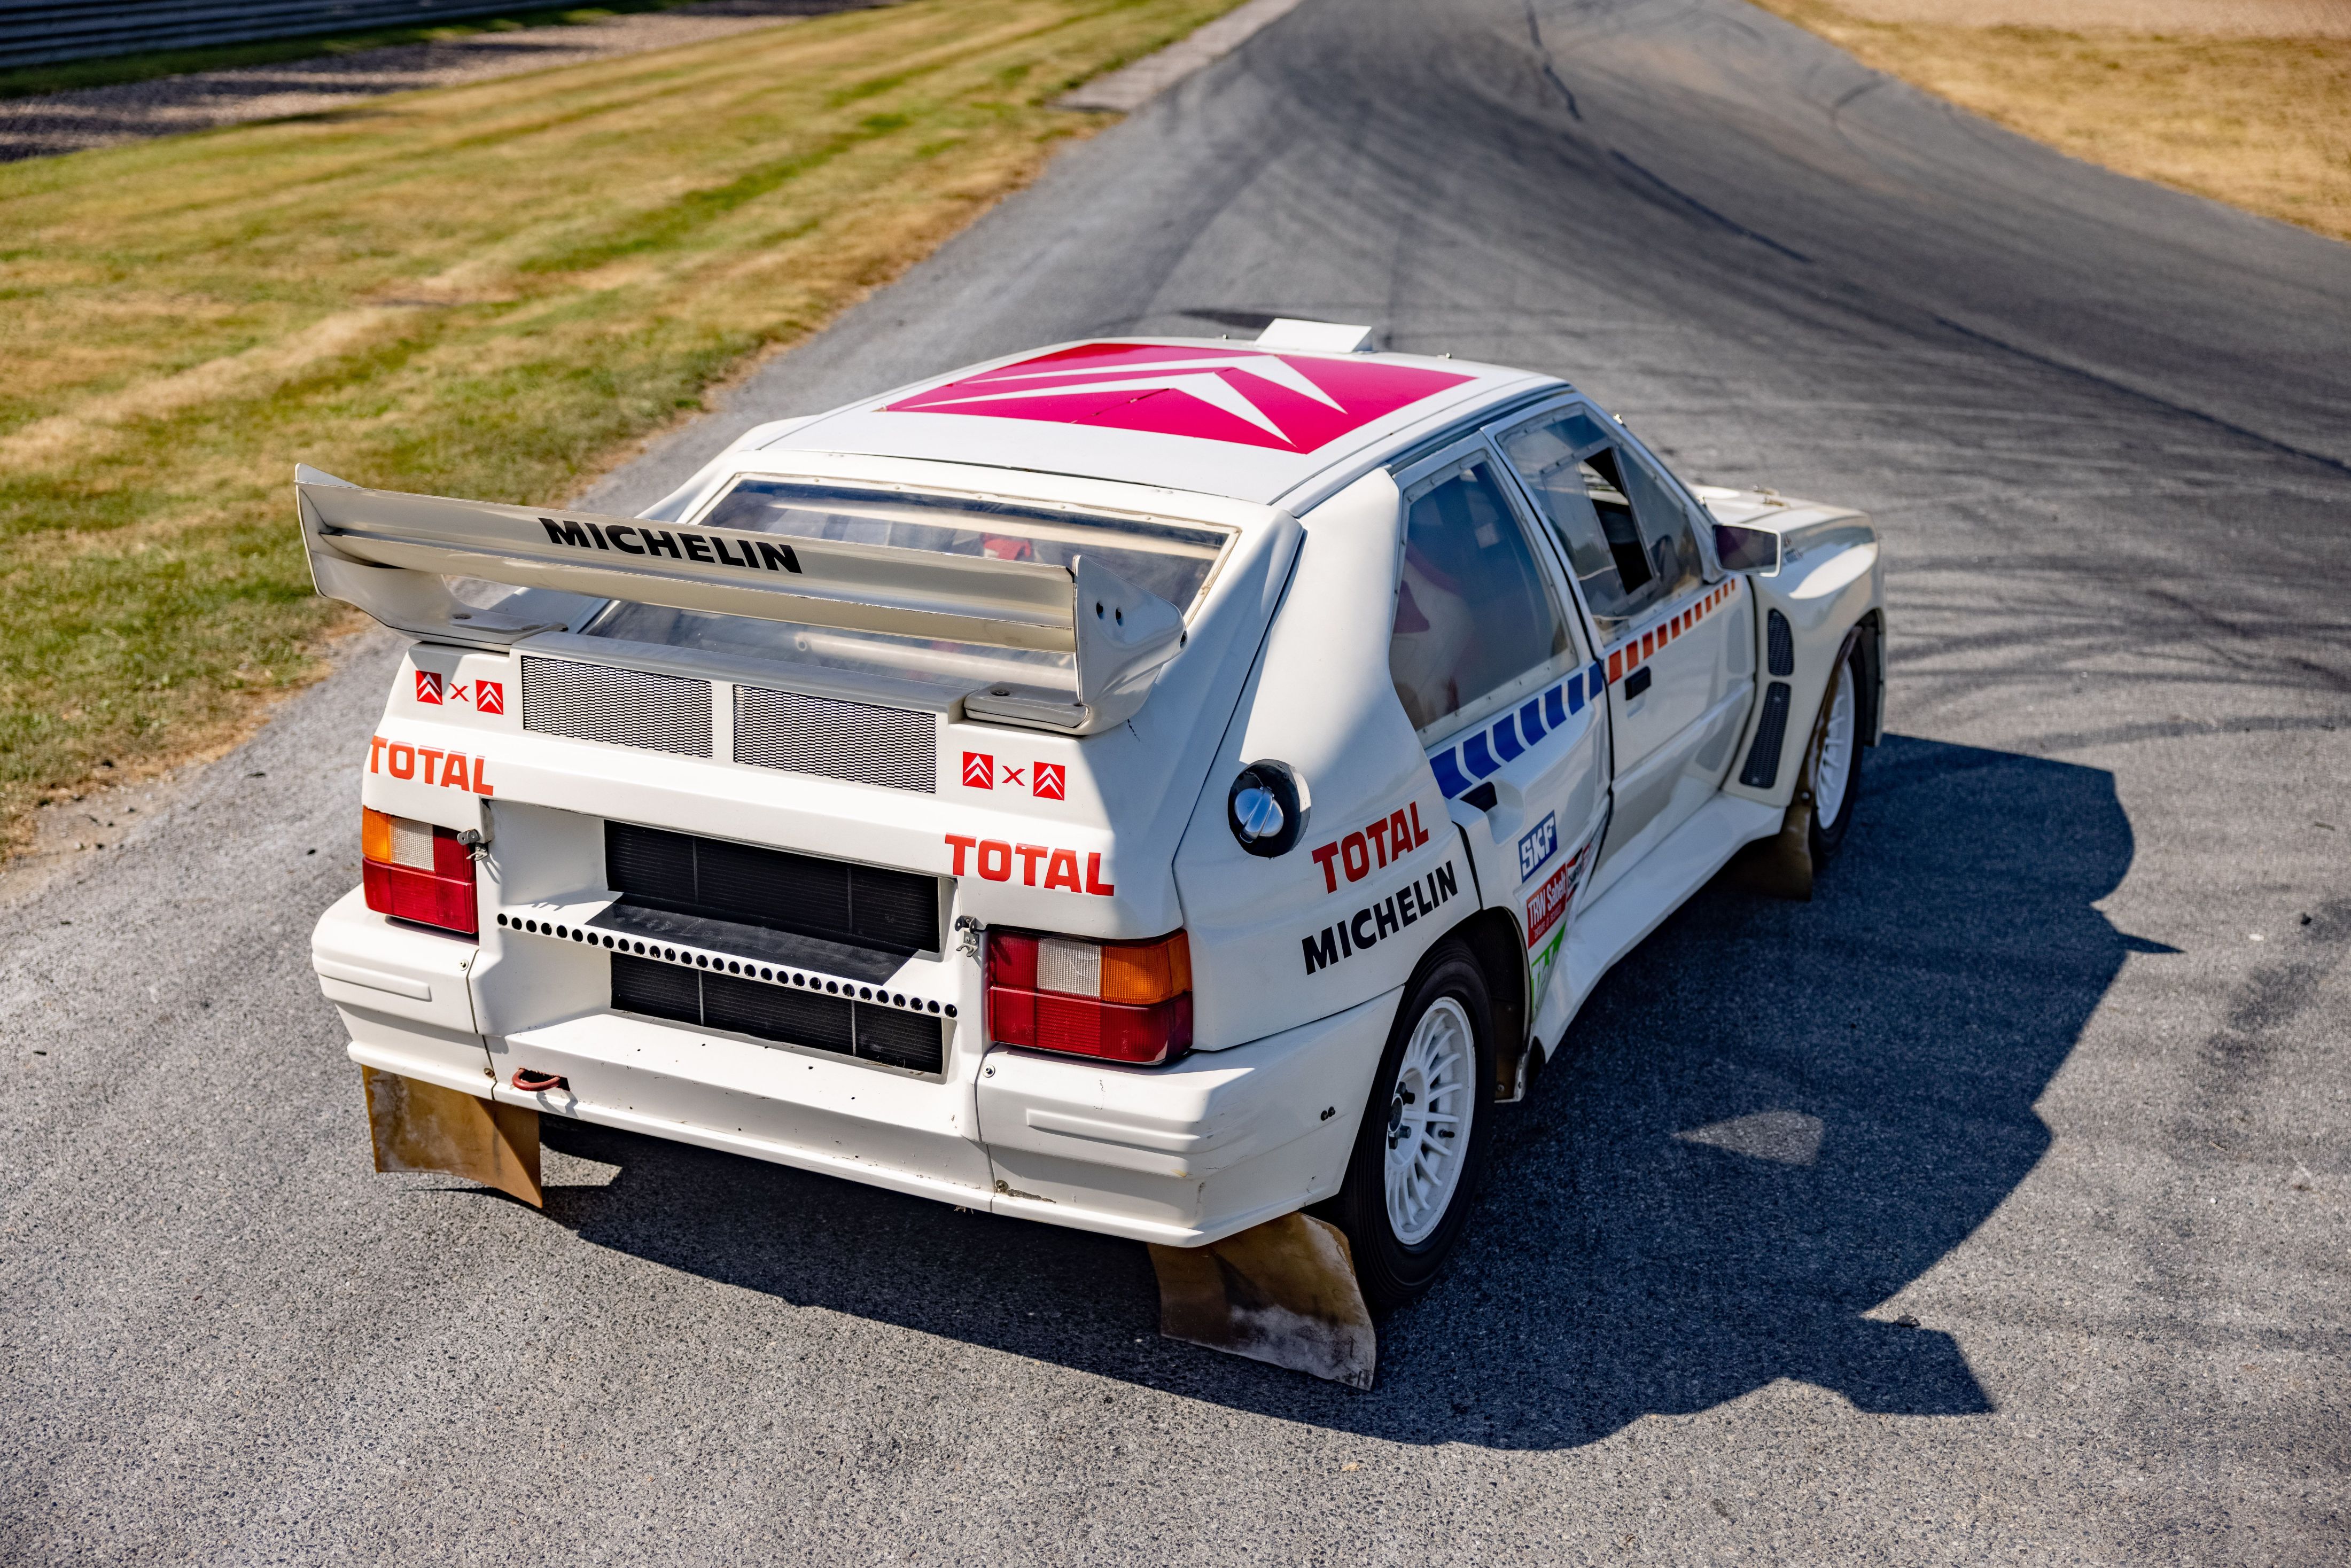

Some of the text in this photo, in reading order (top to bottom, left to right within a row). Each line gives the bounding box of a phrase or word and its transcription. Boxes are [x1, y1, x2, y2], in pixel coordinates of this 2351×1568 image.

[538, 518, 803, 574] MICHELIN
[371, 735, 494, 797] TOTAL
[945, 833, 1115, 896] TOTAL
[1312, 801, 1429, 894] TOTAL
[1521, 815, 1555, 877] SKF
[1301, 860, 1459, 976] MICHELIN
[1528, 888, 1546, 929] TRW
[1546, 870, 1566, 911] Sabelt
